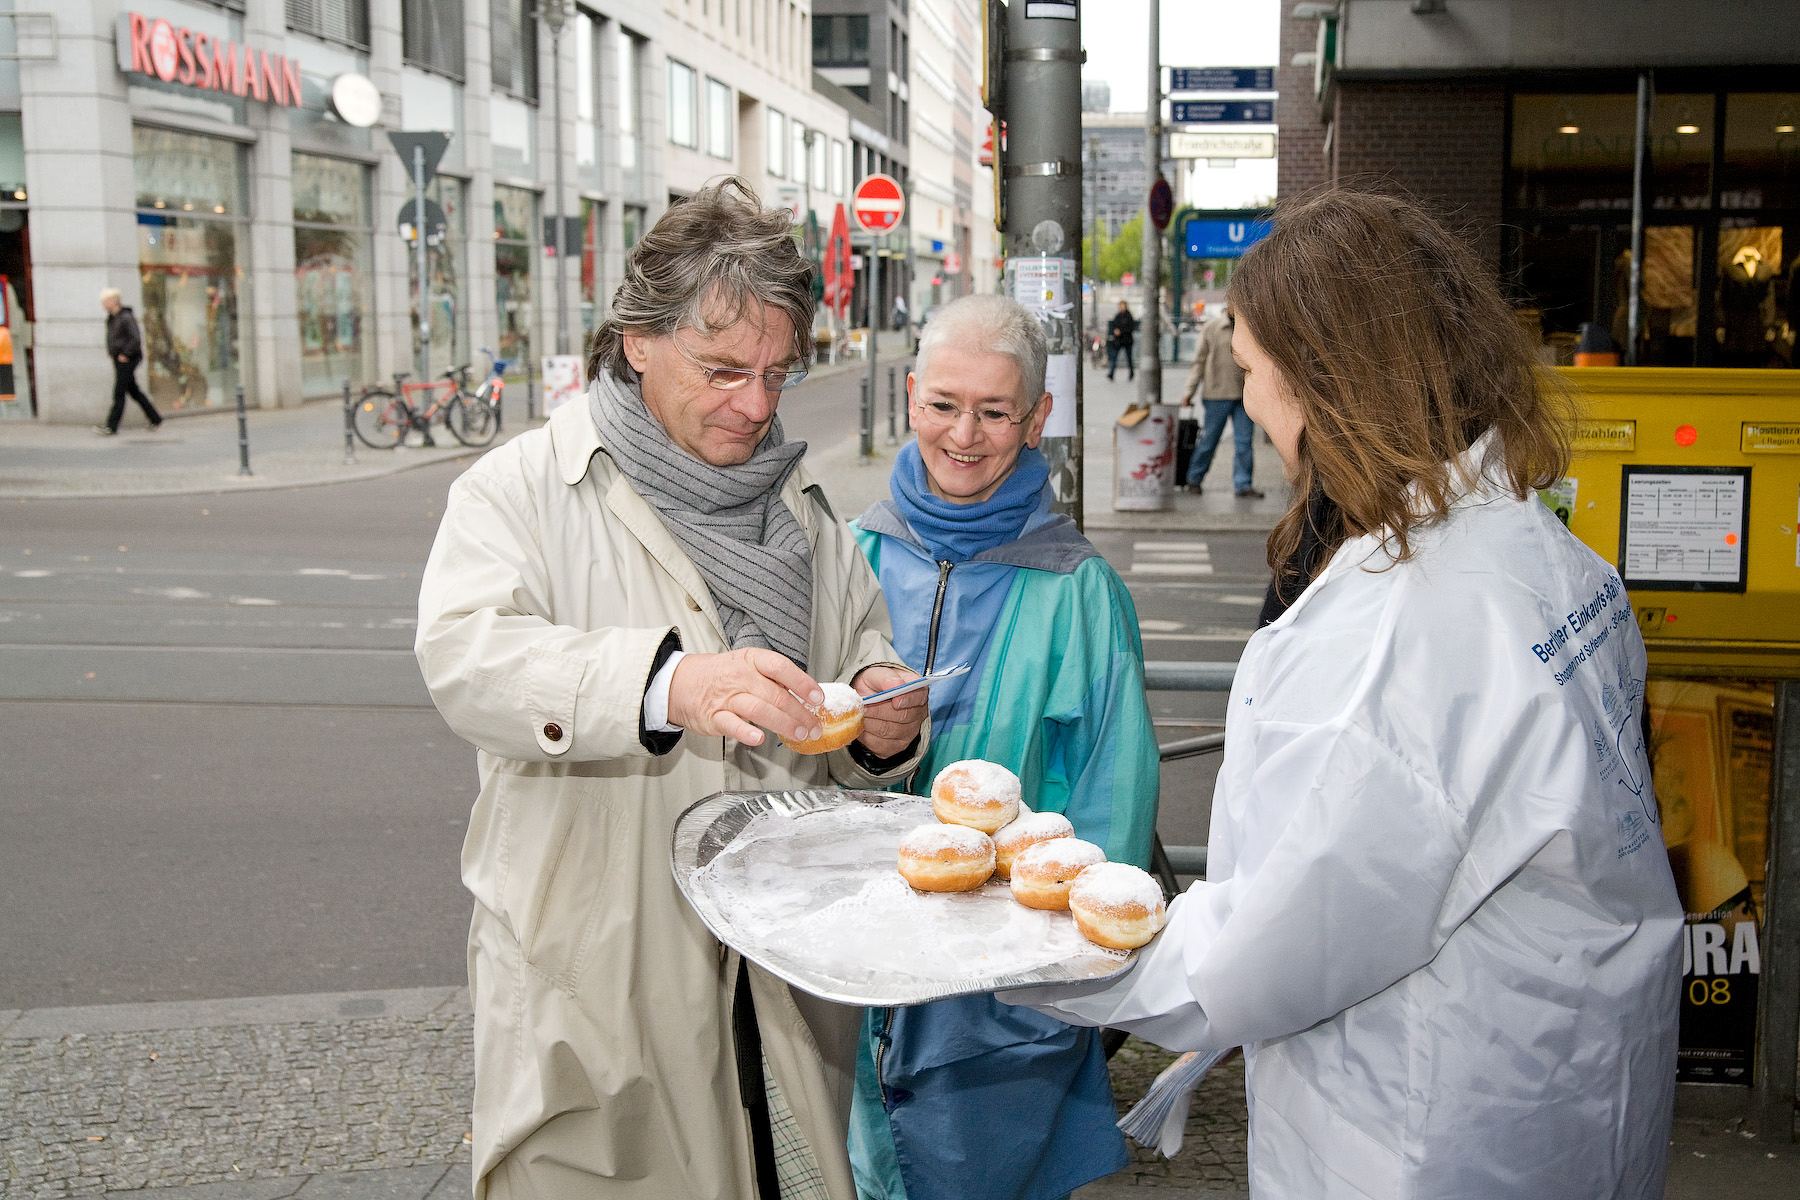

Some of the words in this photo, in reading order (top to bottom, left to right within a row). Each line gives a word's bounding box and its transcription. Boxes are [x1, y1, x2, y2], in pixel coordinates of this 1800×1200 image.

[129, 11, 302, 108] ROSSMANN
[1228, 222, 1245, 242] U
[1689, 978, 1731, 1006] 08
